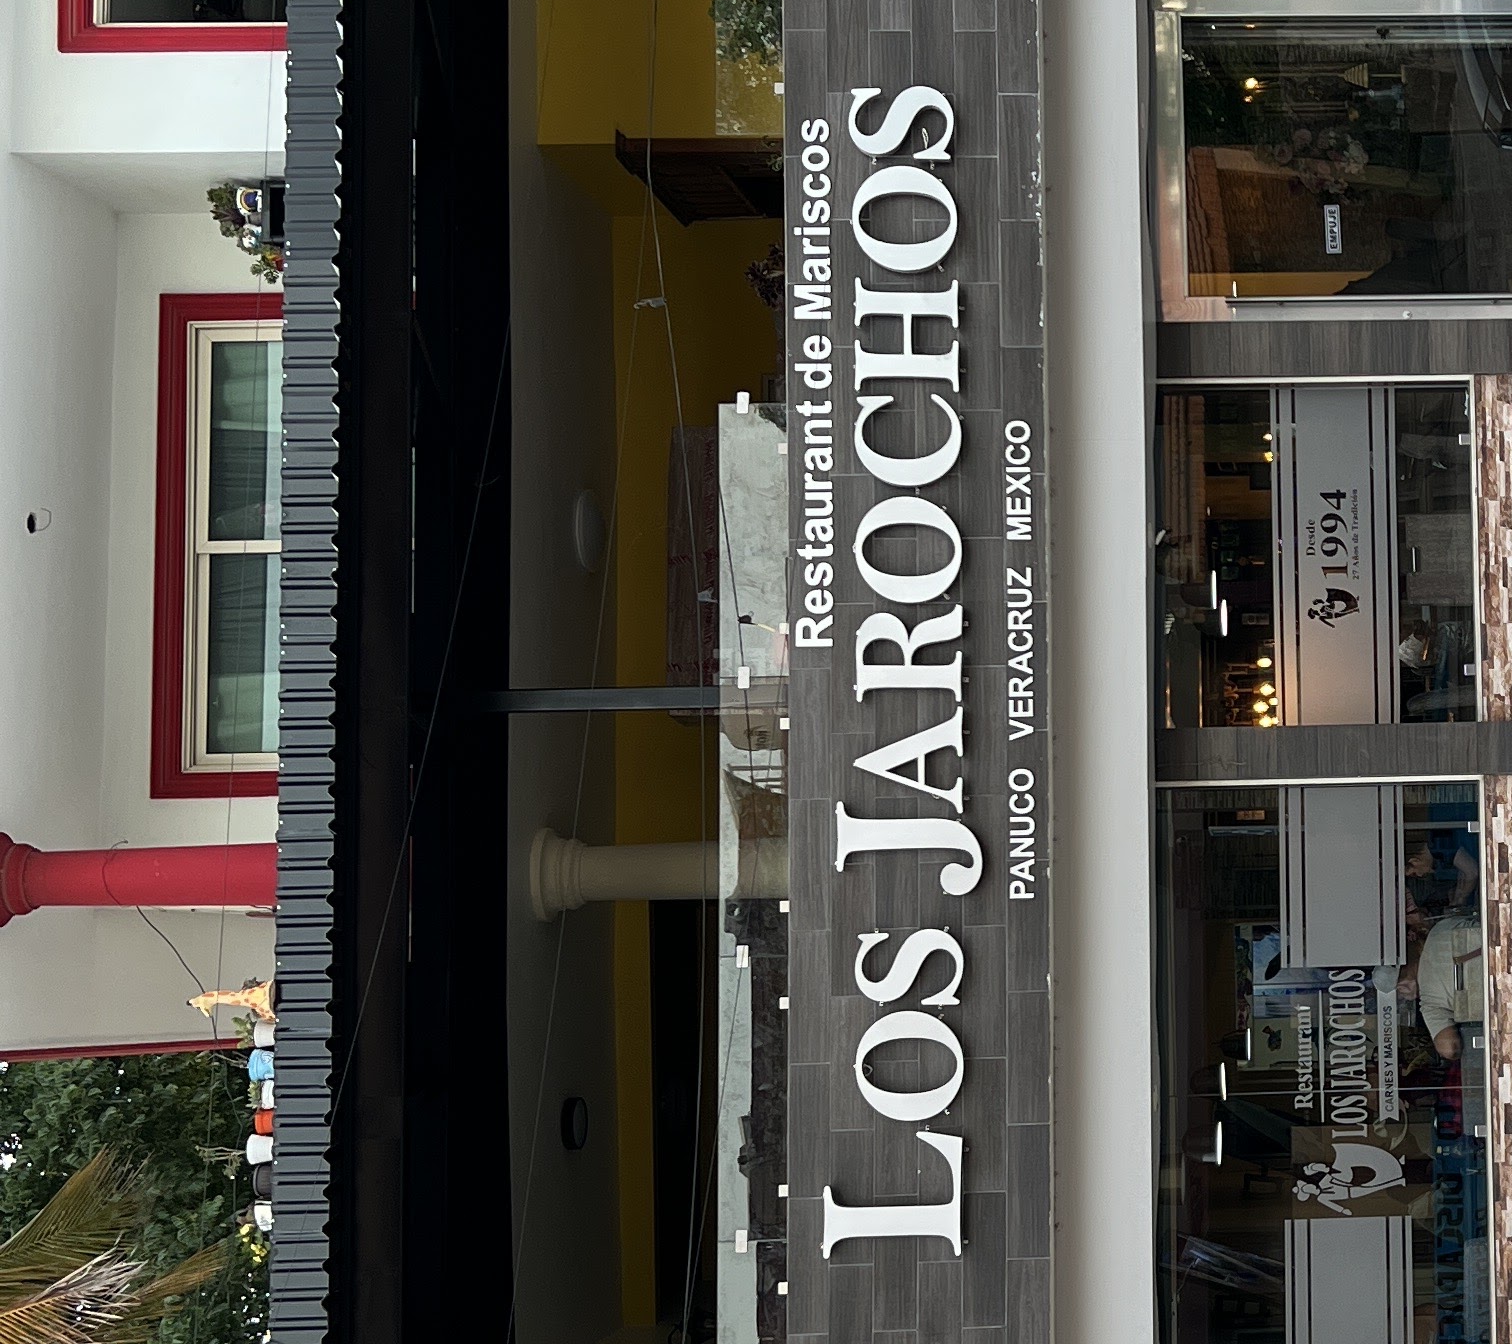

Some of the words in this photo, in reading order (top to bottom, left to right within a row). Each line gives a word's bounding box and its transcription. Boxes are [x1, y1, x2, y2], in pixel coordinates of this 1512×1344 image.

[793, 118, 832, 321] Mariscos
[1328, 208, 1338, 250] EMPUJE
[794, 334, 833, 390] de
[794, 400, 834, 648] Restaurant
[833, 85, 984, 896] JAROCHOS
[1004, 419, 1032, 541] MEXICO
[1305, 518, 1316, 557] Desde
[1319, 488, 1349, 580] 1994
[1006, 566, 1034, 741] VERACRUZ
[1008, 768, 1036, 900] PANUCO
[1293, 1003, 1314, 1110] Restaurant
[1326, 968, 1372, 1089] JAROCHOS
[1382, 1005, 1394, 1059] MARISCOS
[1383, 1061, 1394, 1069] Y
[820, 927, 966, 1260] LOS
[1328, 1095, 1369, 1139] LOS
[1383, 1070, 1395, 1113] CARNES
